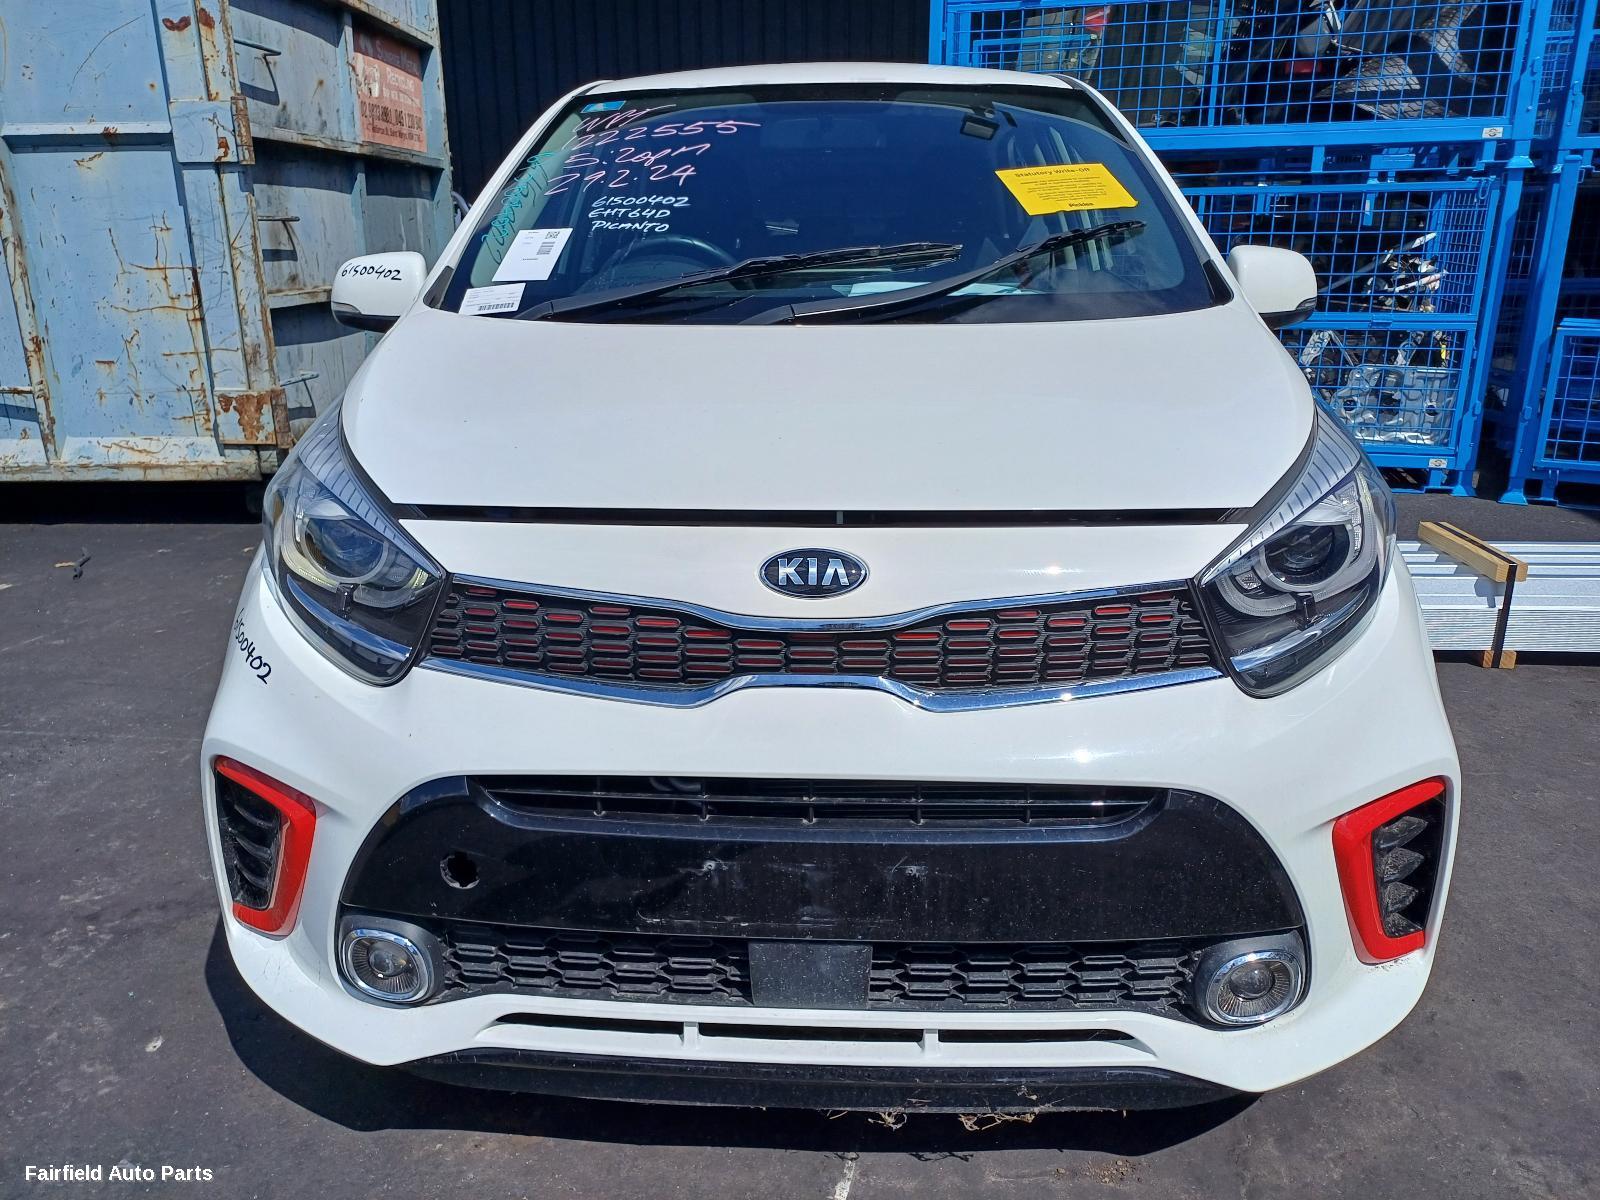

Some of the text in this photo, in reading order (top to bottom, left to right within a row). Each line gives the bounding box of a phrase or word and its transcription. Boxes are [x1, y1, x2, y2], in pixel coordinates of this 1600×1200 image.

[592, 195, 691, 207] 61500402
[591, 220, 670, 232] PICANTO
[341, 262, 402, 281] 61500402
[777, 557, 850, 586] KIA
